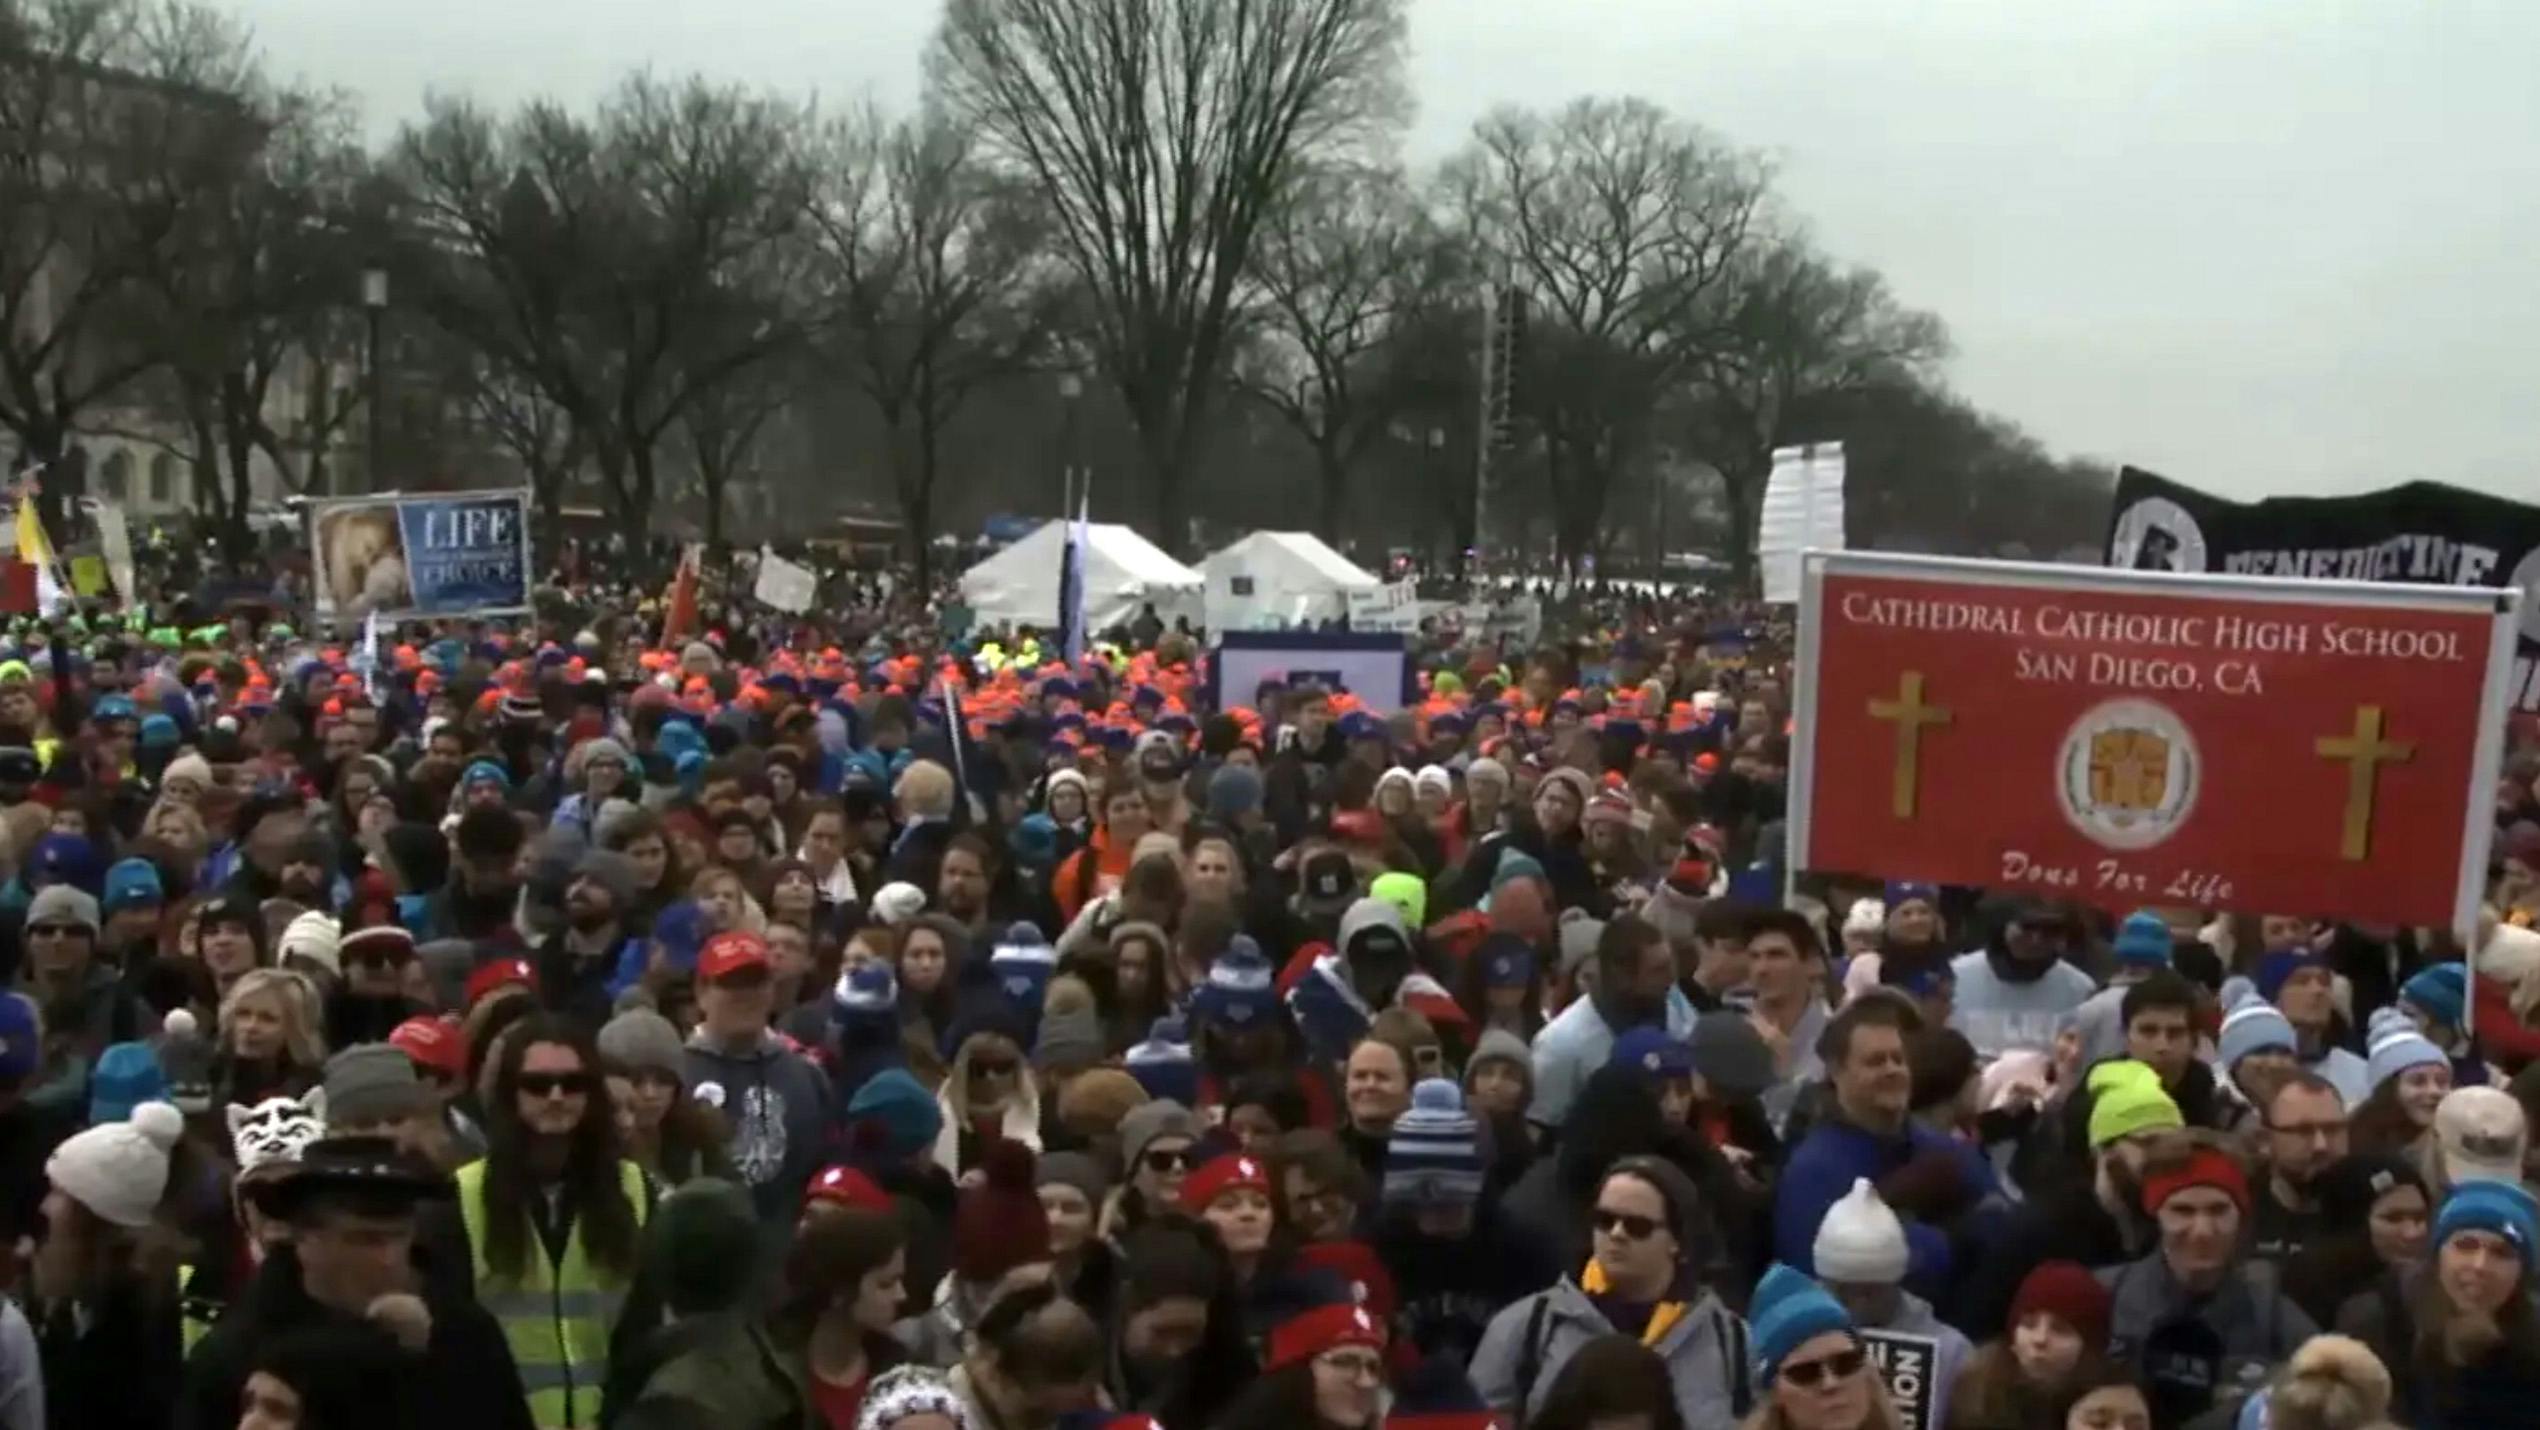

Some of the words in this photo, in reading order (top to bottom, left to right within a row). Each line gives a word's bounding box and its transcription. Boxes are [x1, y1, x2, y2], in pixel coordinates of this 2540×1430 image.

[424, 508, 514, 547] LIFE
[1843, 592, 2024, 635] CATHEDRAL
[2036, 605, 2204, 647] CATHOLIC
[2213, 616, 2308, 654] HIGH
[2320, 622, 2464, 660] SCHOOL
[2014, 648, 2078, 681] SAN
[2089, 652, 2203, 692] DIEGO,
[2213, 661, 2263, 694] CA
[2002, 850, 2079, 887] Dons
[2096, 859, 2148, 890] For
[2163, 869, 2233, 904] Life
